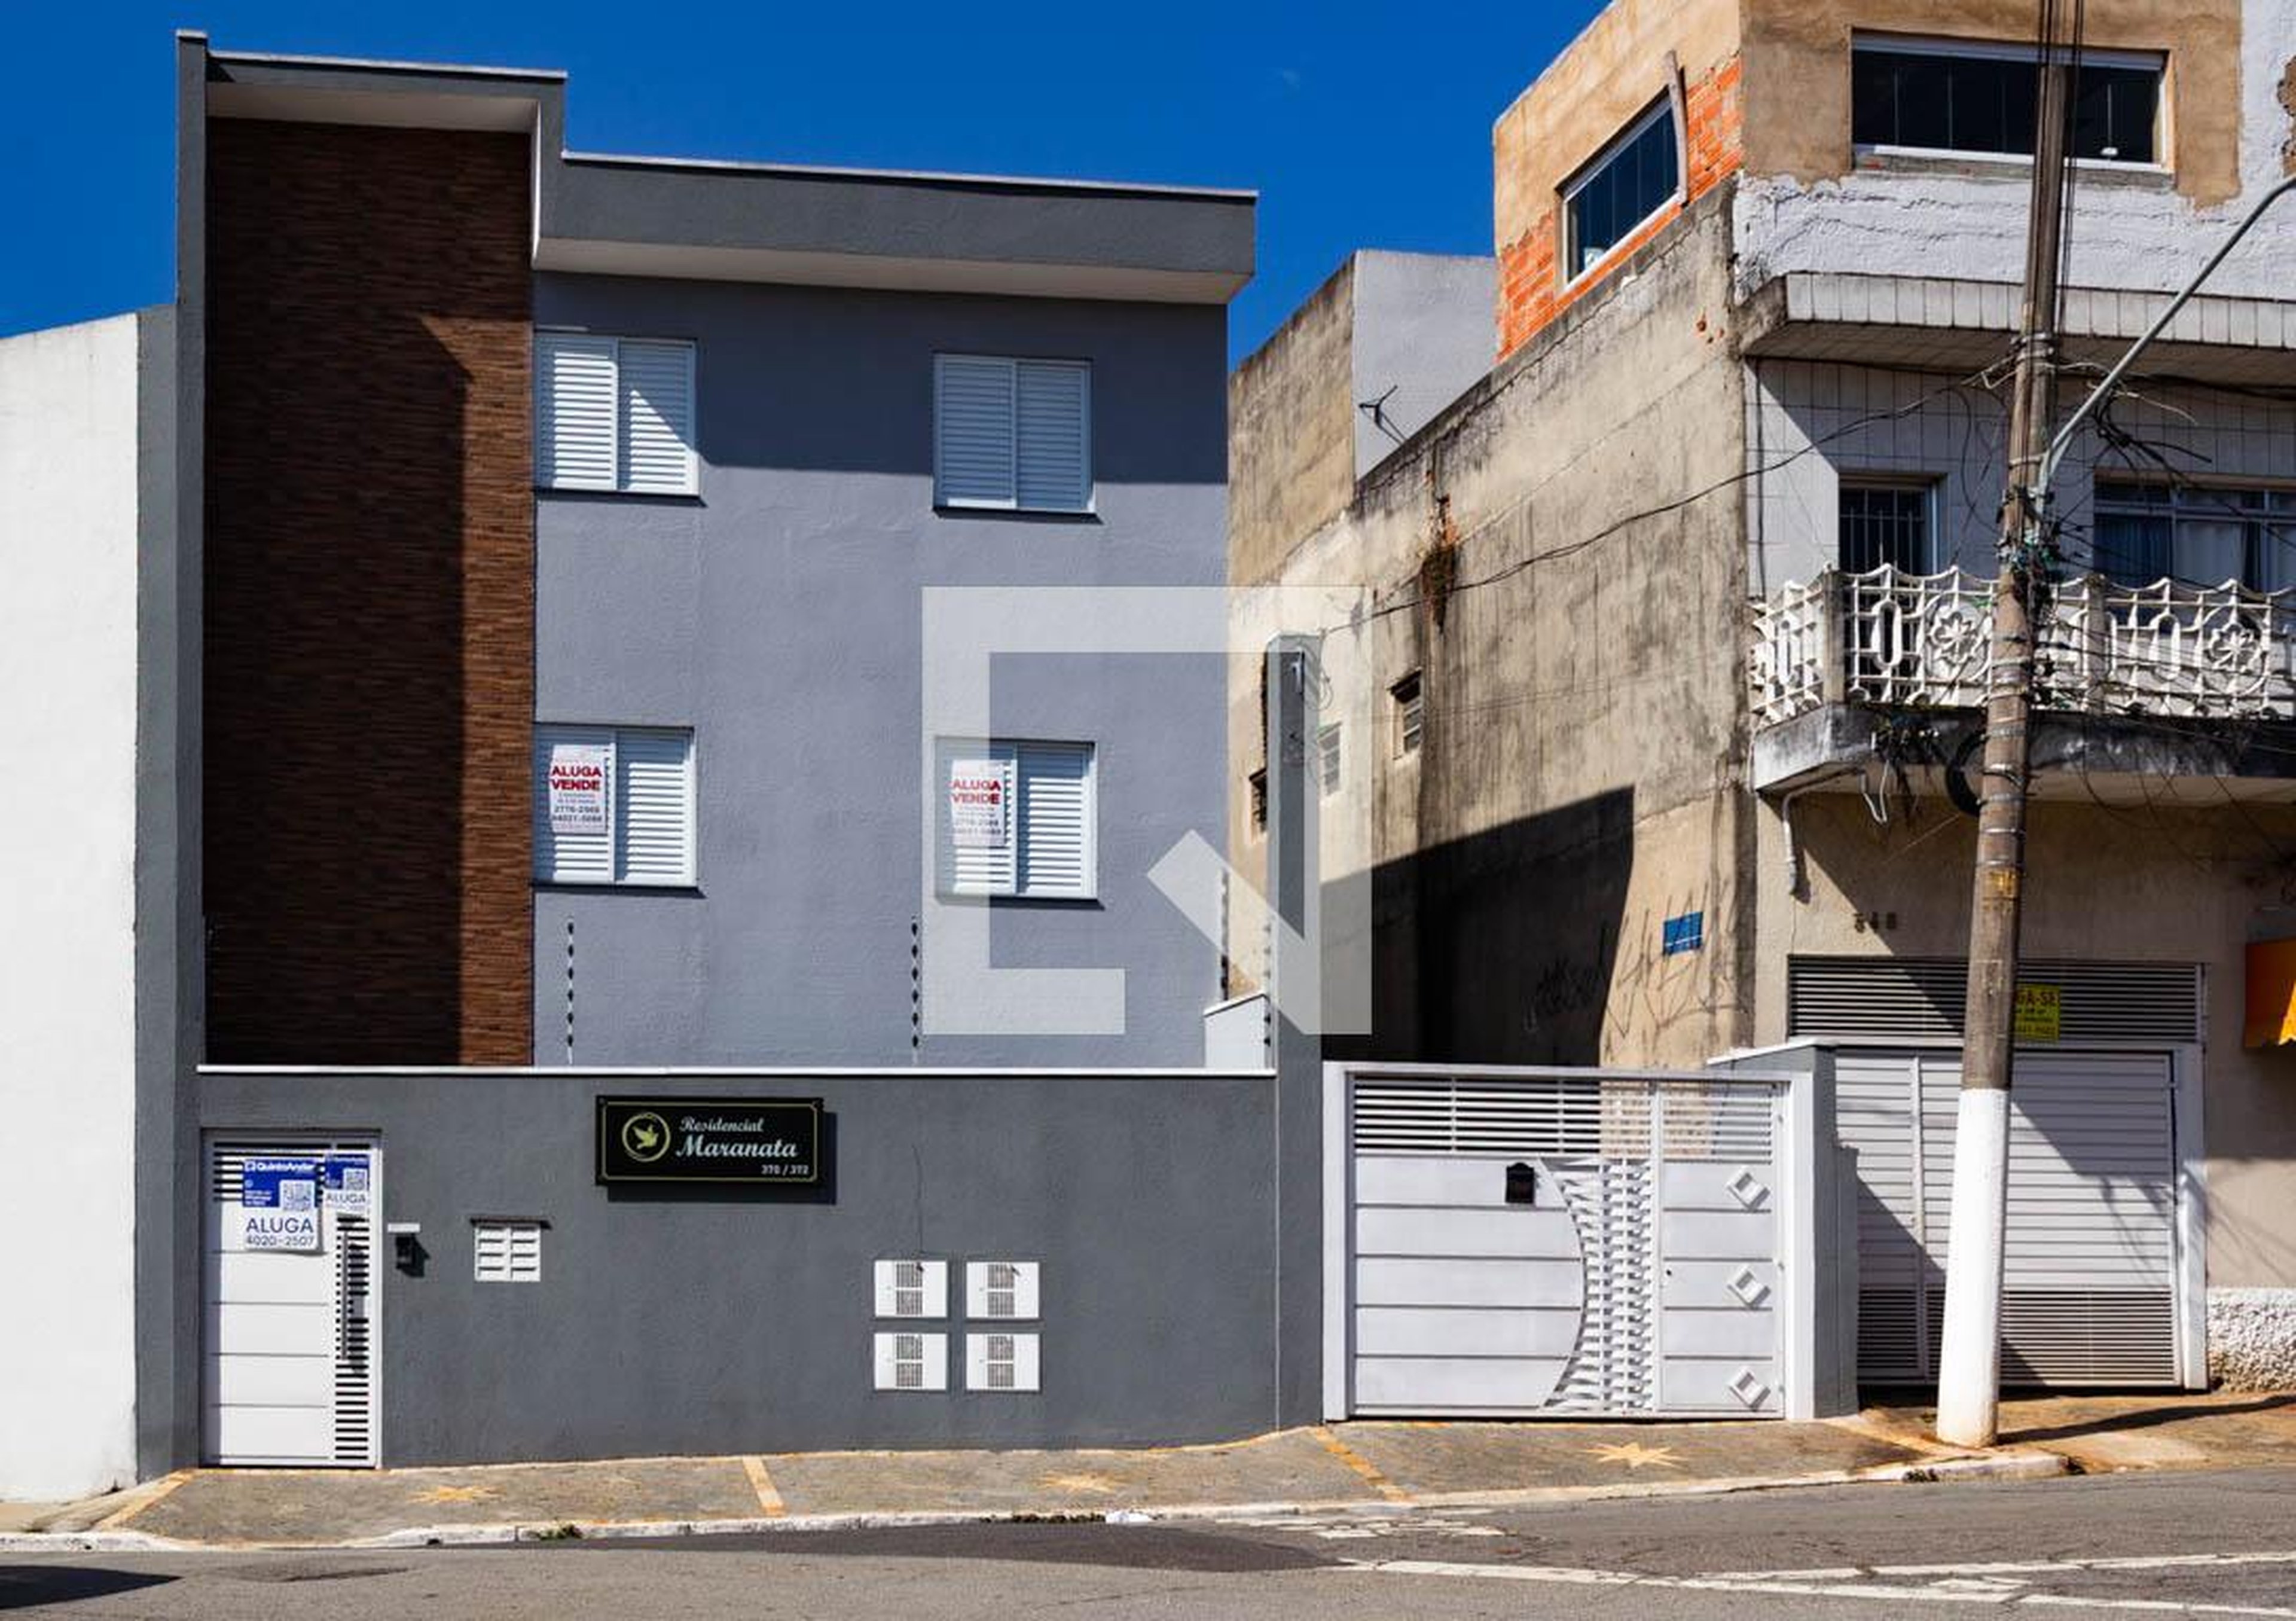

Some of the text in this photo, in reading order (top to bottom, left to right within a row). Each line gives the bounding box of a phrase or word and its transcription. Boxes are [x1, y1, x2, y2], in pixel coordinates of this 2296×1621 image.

[551, 765, 602, 777] ALUGA
[551, 779, 600, 790] VENDE
[952, 780, 1001, 791] ALUGA
[951, 793, 1000, 805] VENDE
[679, 1116, 764, 1132] Residencial
[676, 1134, 798, 1158] Maranata
[325, 1192, 367, 1203] ALUGA
[246, 1217, 314, 1234] ALUGA
[246, 1235, 314, 1247] 4020-2507
